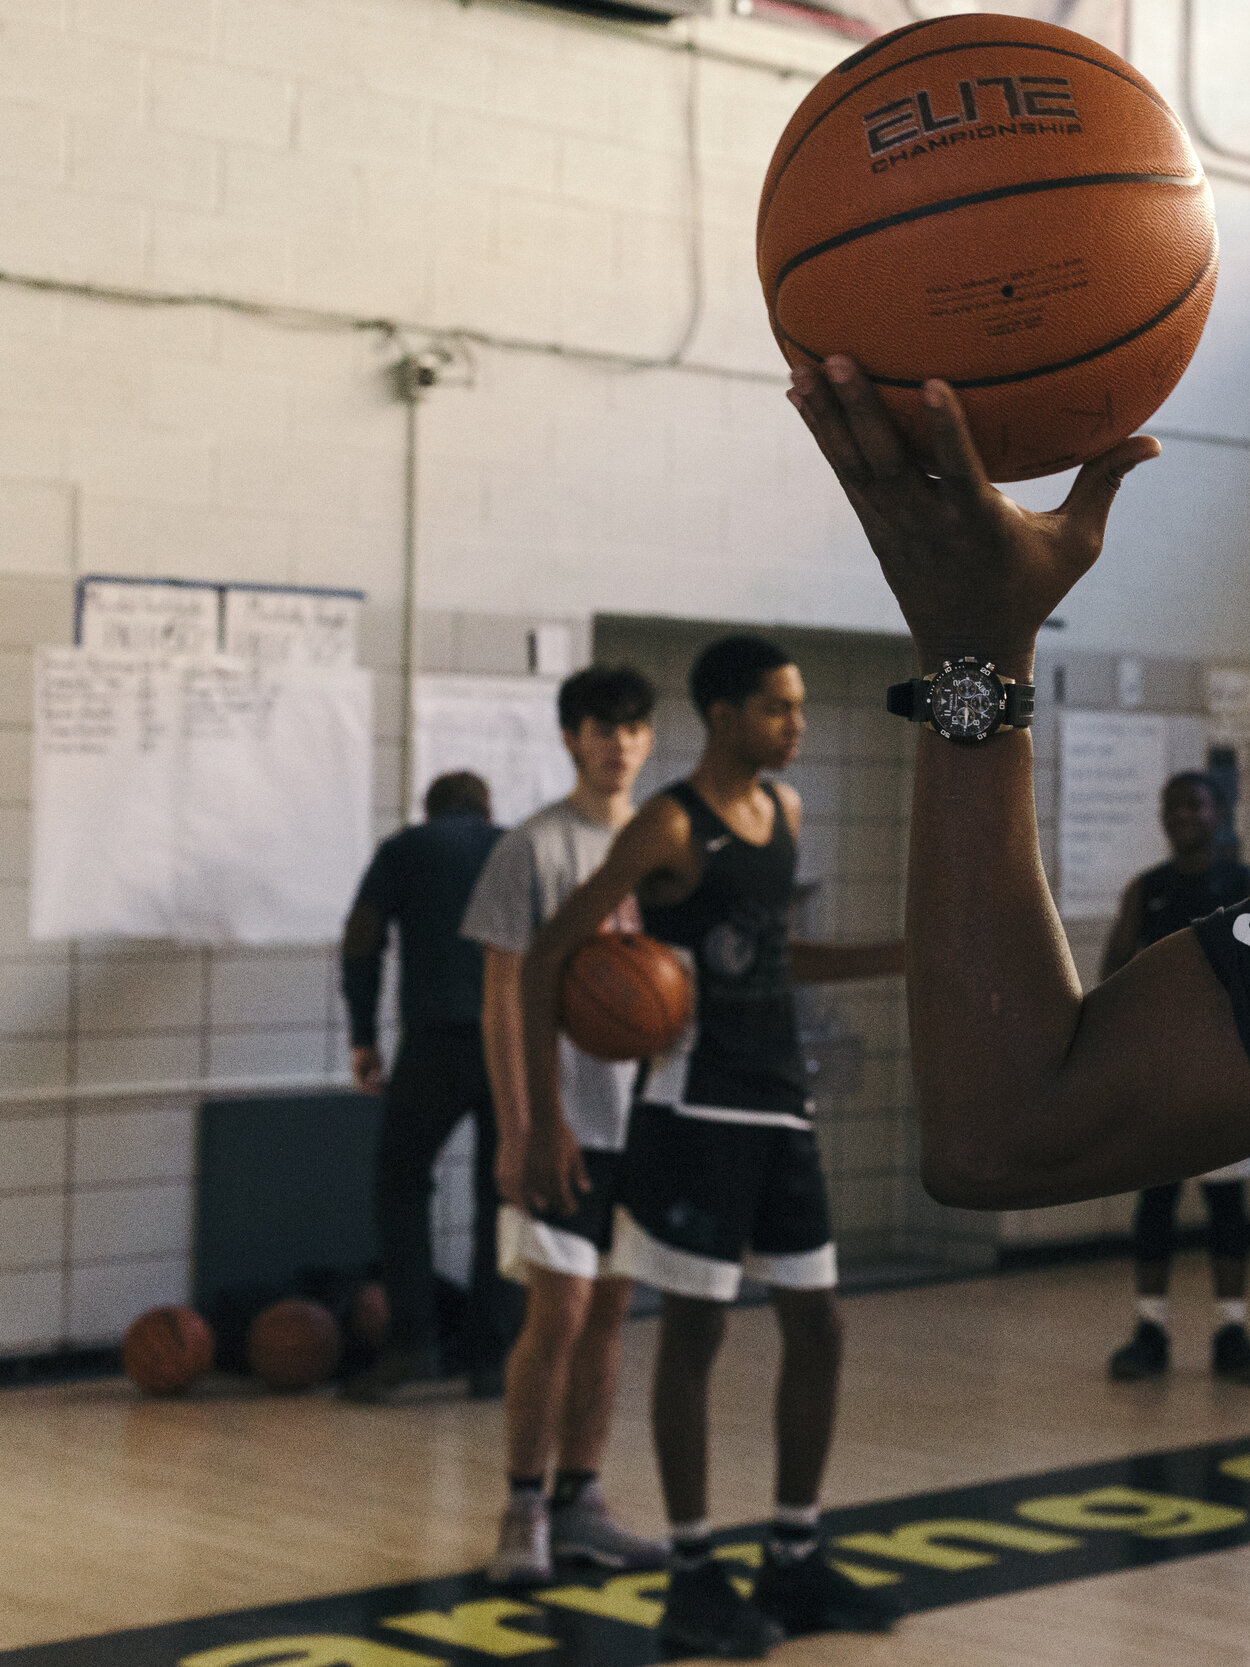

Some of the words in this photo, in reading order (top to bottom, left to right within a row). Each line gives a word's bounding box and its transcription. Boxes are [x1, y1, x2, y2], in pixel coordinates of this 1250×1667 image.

[863, 75, 1081, 158] ELITE
[871, 122, 1083, 174] CHAMPIONSHIP
[980, 667, 991, 676] 20
[1000, 700, 1005, 710] 30
[940, 729, 950, 738] 50
[977, 732, 987, 740] 40
